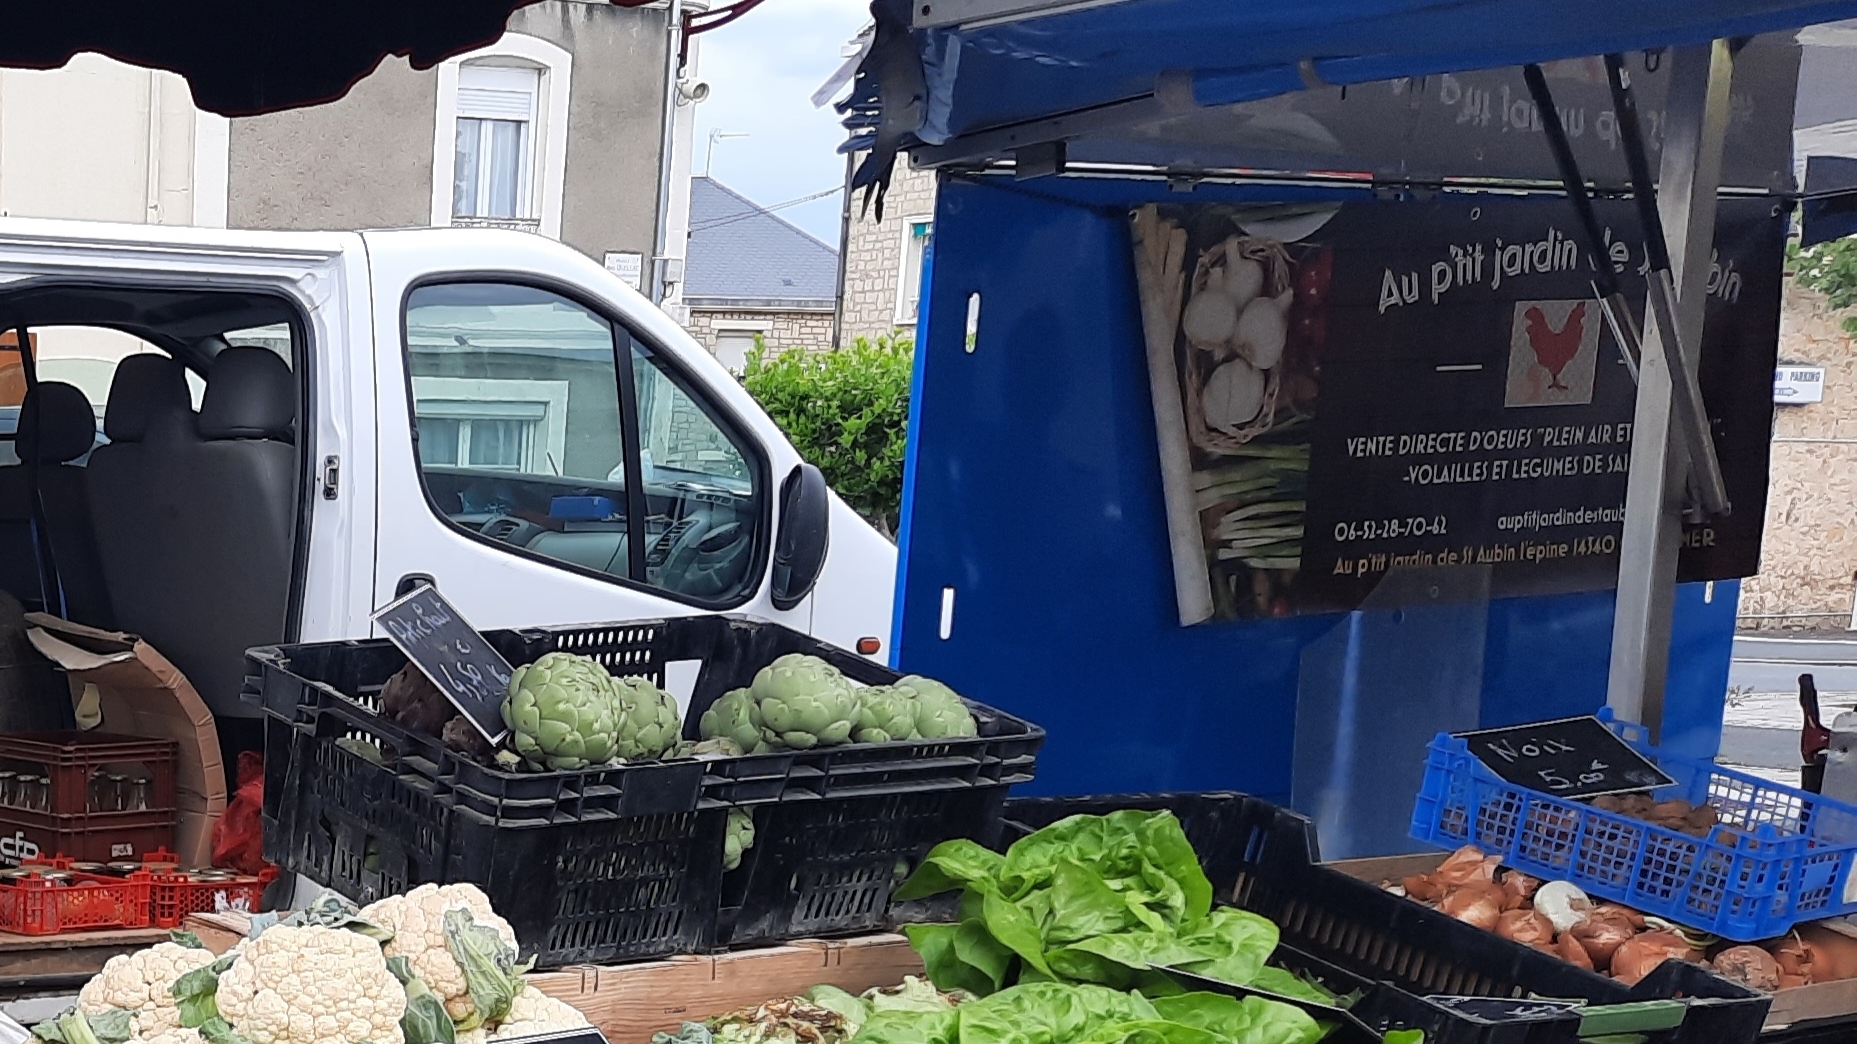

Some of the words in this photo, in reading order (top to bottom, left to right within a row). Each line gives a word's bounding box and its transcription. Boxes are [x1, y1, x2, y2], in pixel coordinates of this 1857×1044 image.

[1378, 268, 1420, 314] Au
[1431, 244, 1486, 305] p'tit
[1491, 227, 1577, 290] jardin
[1347, 435, 1394, 457] VENTE
[1399, 432, 1466, 455] DIRECTE
[1469, 428, 1532, 451] D'OEUFS
[1587, 424, 1612, 444] AIR
[1616, 423, 1632, 442] ET
[1492, 459, 1509, 480] ET
[1512, 455, 1578, 480] LEGUMES
[1583, 454, 1603, 474] DE
[1333, 557, 1353, 575] Au
[1357, 553, 1386, 578] p'tit
[1437, 548, 1458, 565] de
[1477, 542, 1515, 563] Aubin
[1520, 541, 1569, 564] l'épine
[1573, 535, 1615, 556] 14340
